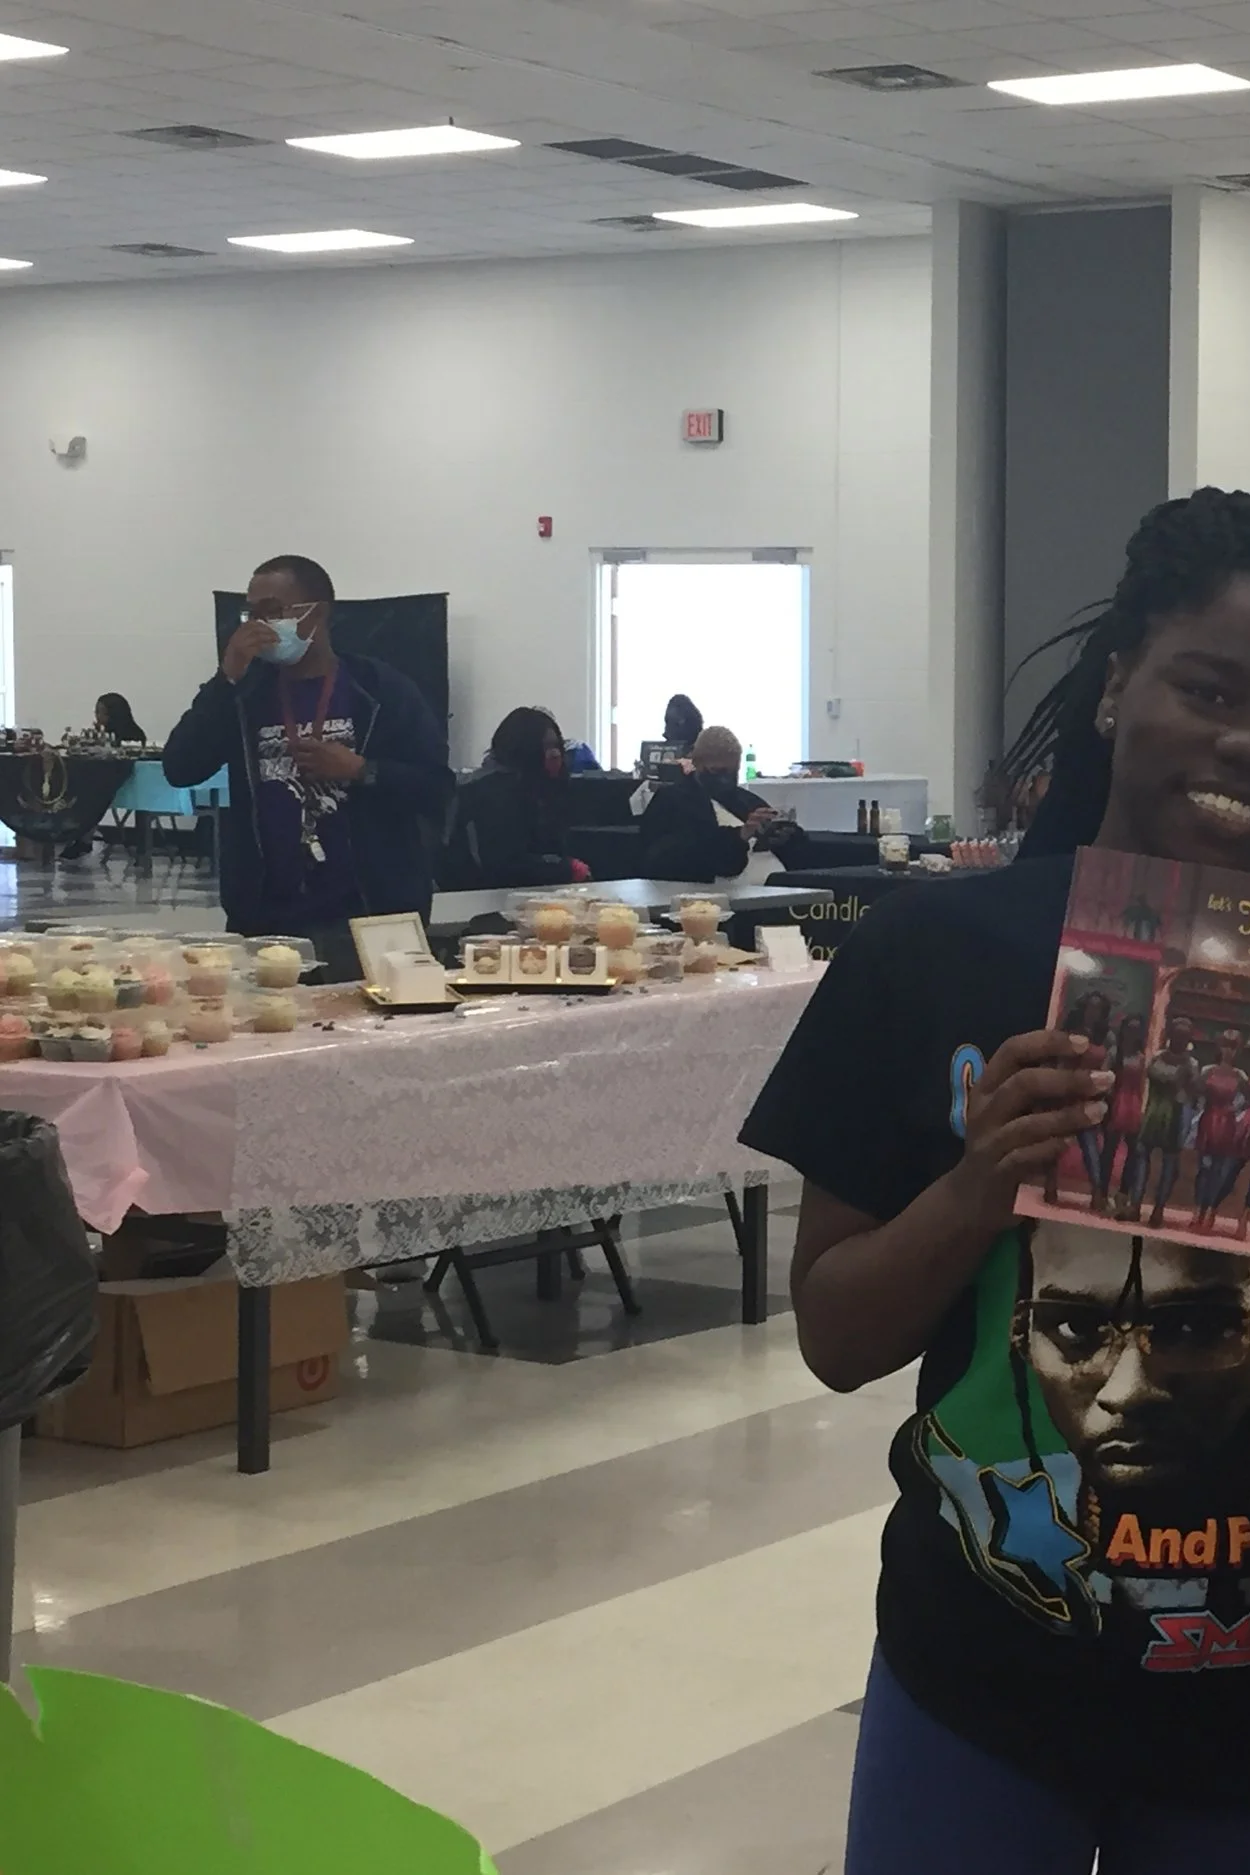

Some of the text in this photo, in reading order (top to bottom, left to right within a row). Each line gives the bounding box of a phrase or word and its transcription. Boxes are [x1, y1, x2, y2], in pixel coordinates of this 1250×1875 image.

[687, 412, 713, 437] EXIT
[804, 936, 838, 961] ax
[1105, 1513, 1218, 1571] And
